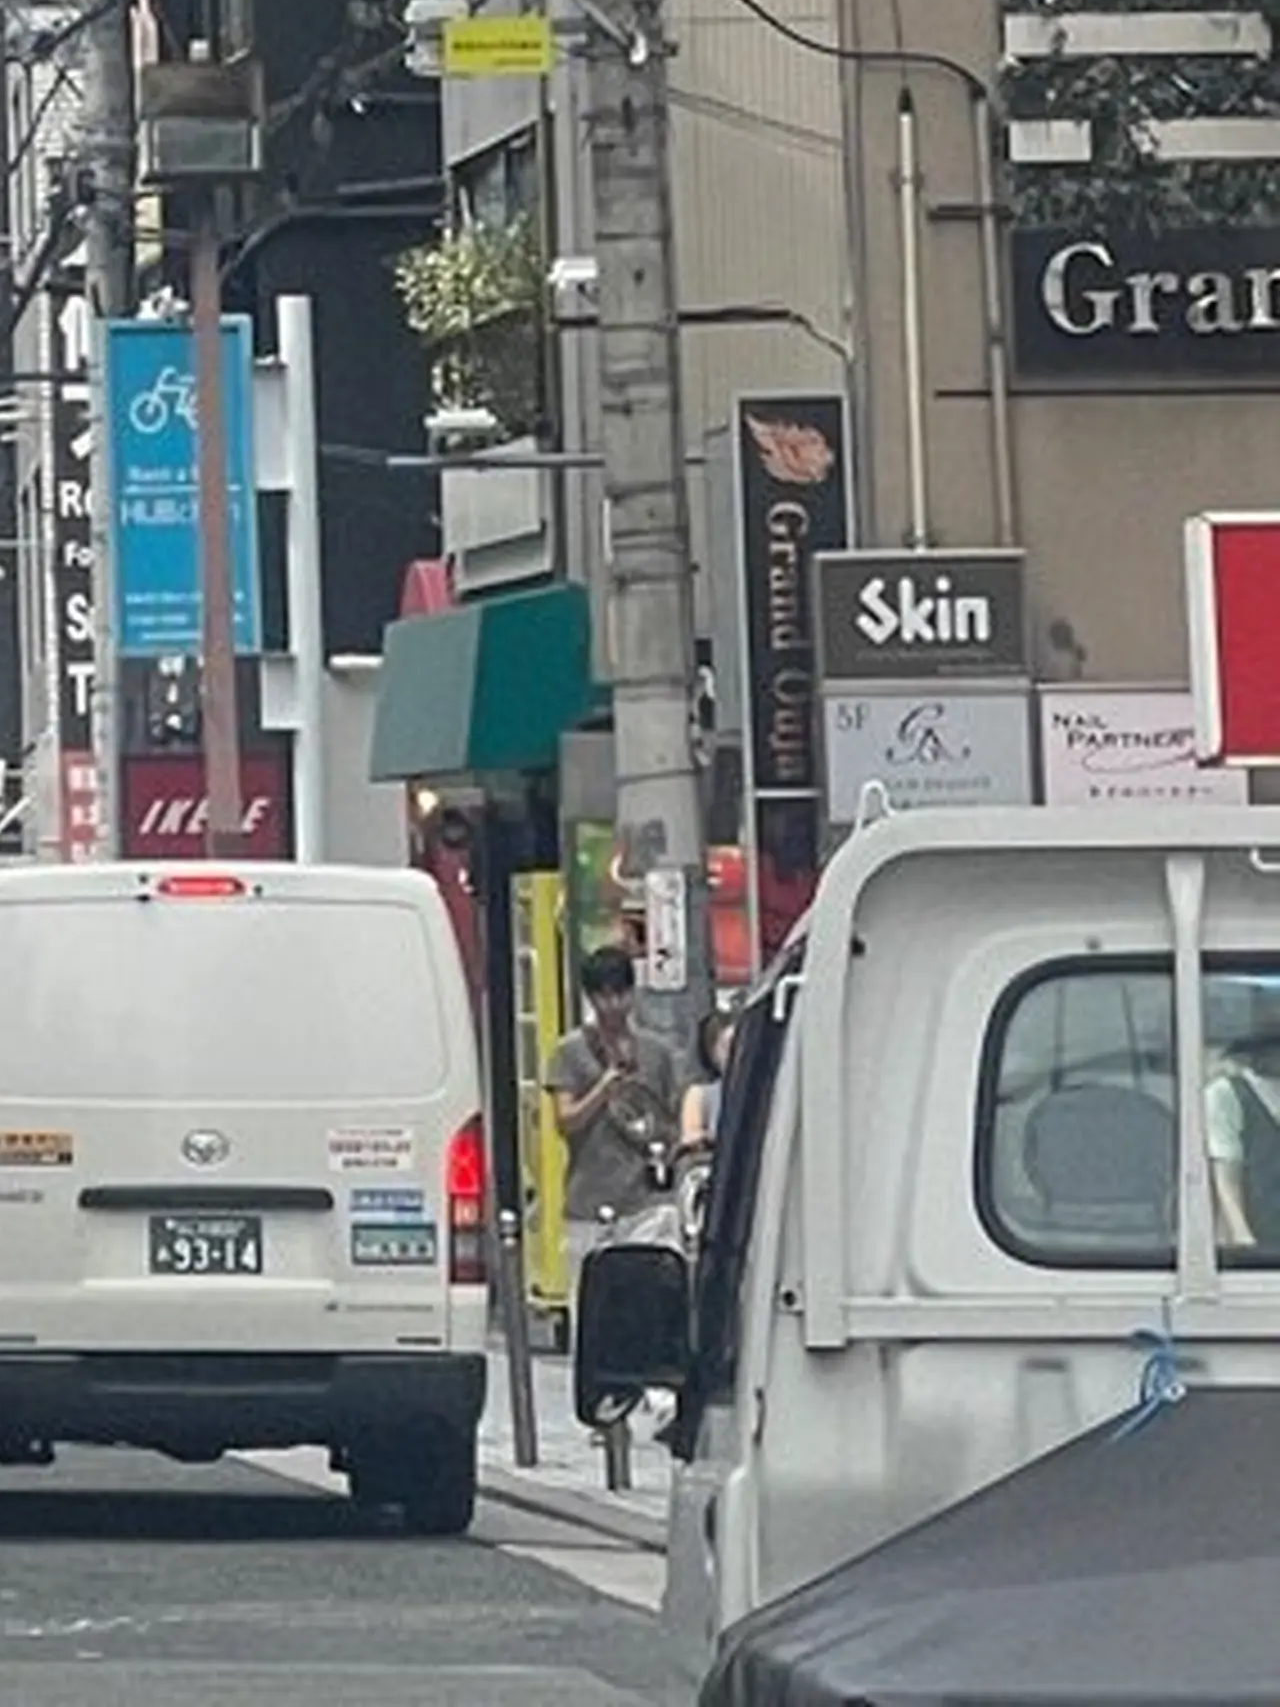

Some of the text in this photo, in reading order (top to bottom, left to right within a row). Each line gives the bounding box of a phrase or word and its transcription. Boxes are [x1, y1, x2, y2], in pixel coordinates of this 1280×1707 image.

[857, 576, 991, 644] Skin
[1052, 711, 1109, 735] NAIL
[141, 796, 268, 834] IKEE
[172, 1236, 259, 1273] 93-14
